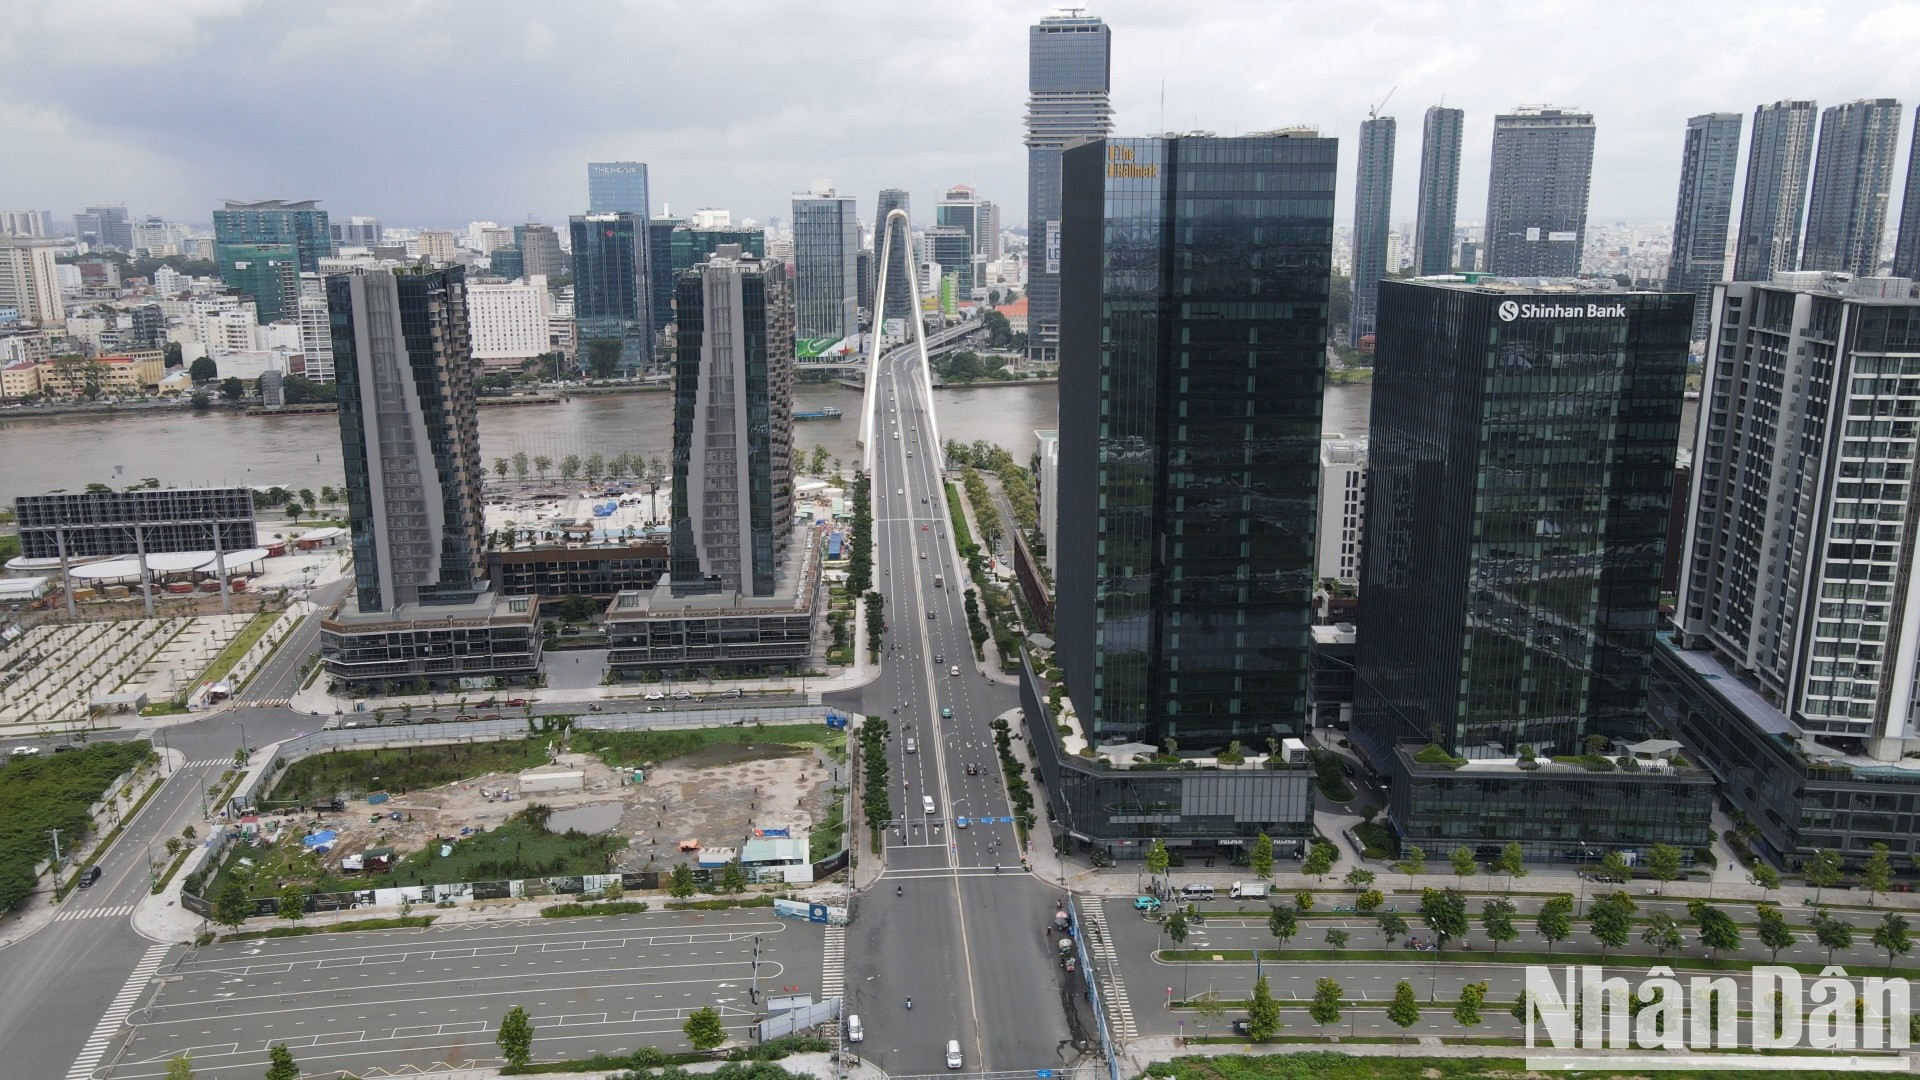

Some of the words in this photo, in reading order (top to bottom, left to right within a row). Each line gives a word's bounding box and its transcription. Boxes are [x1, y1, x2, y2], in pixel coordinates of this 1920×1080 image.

[1117, 144, 1134, 160] The
[1117, 163, 1157, 178] Hallmark
[1520, 303, 1583, 318] Shinhan
[1587, 303, 1626, 318] Bank
